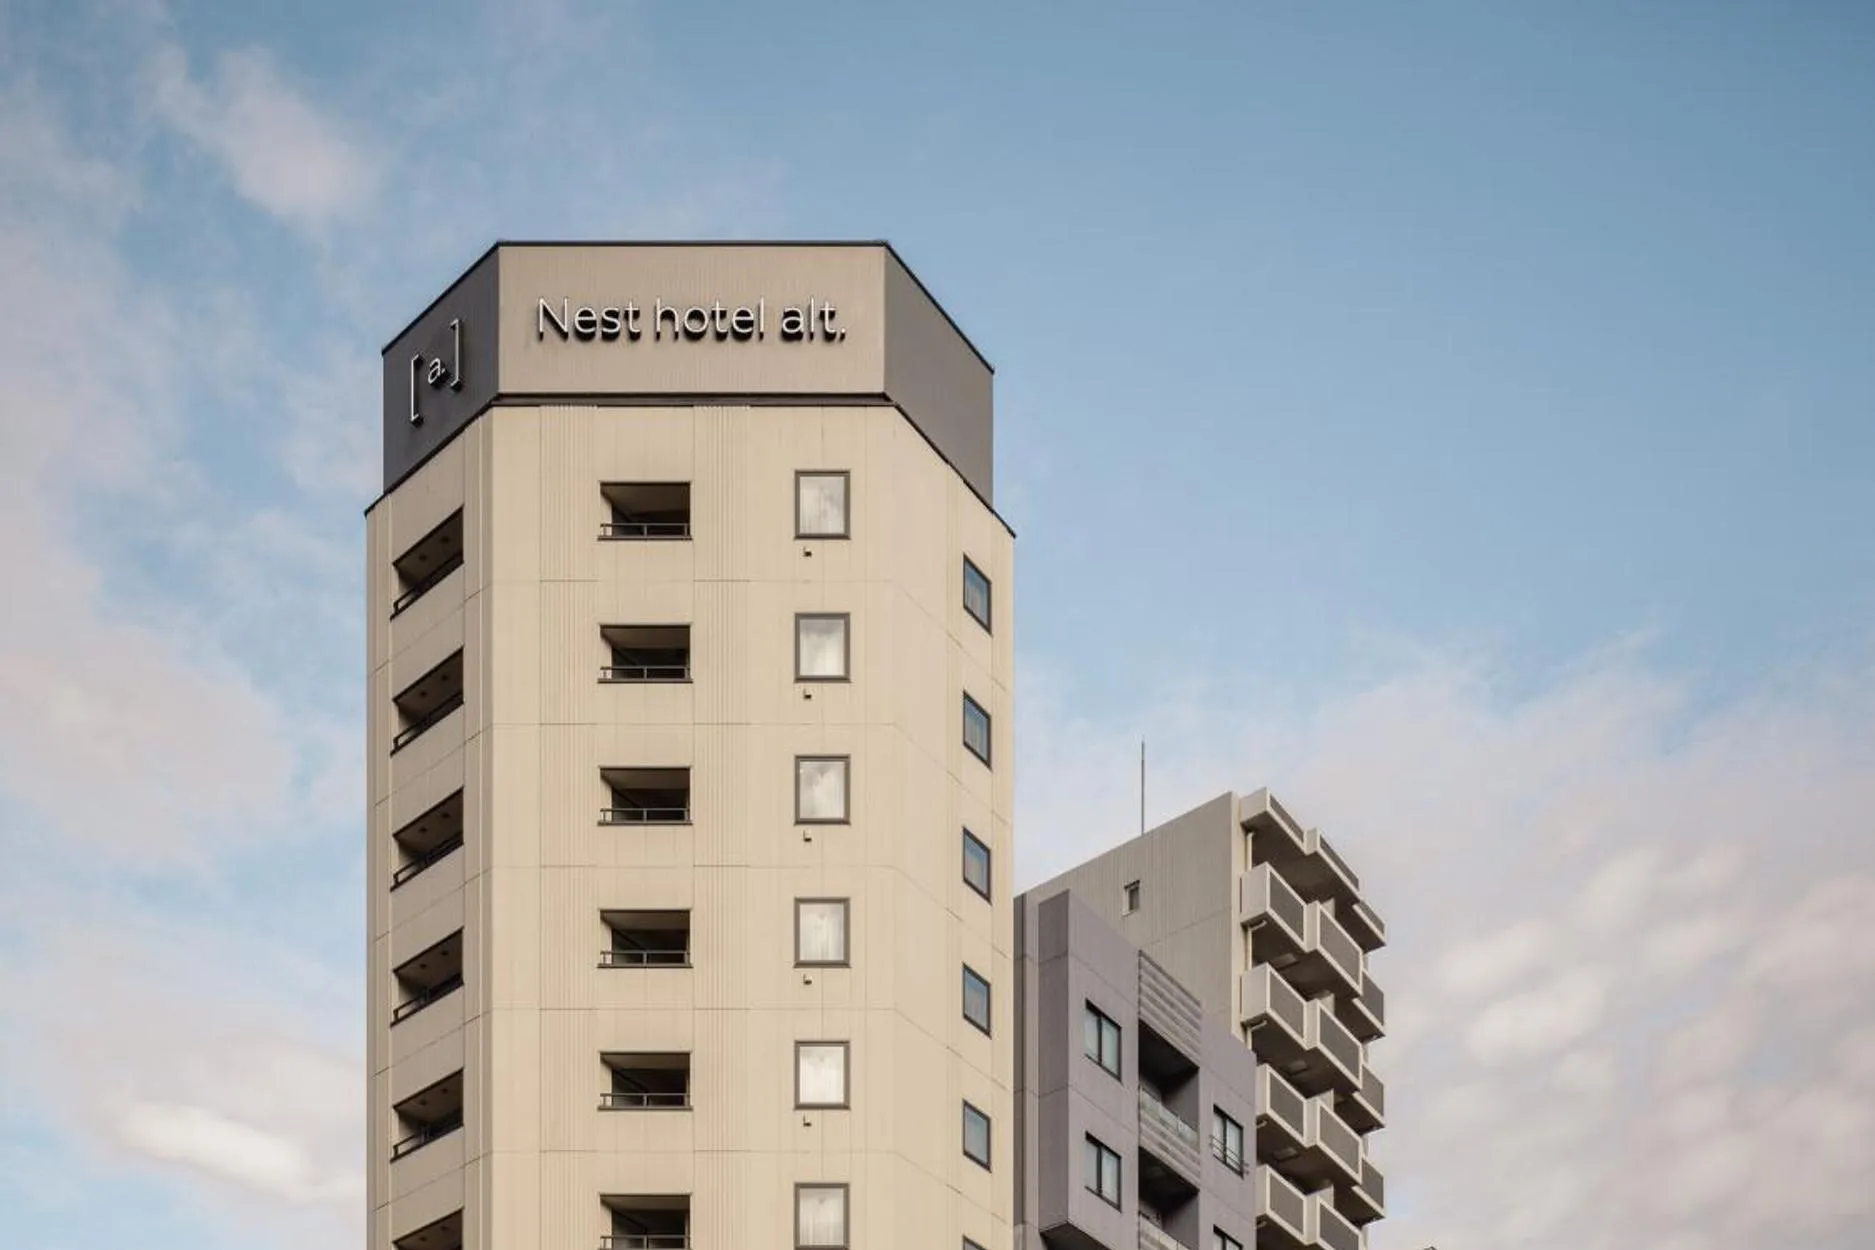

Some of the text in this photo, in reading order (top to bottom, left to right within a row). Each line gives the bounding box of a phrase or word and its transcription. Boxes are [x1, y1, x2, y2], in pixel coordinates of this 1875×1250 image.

[537, 296, 848, 339] Nest hotel alt.
